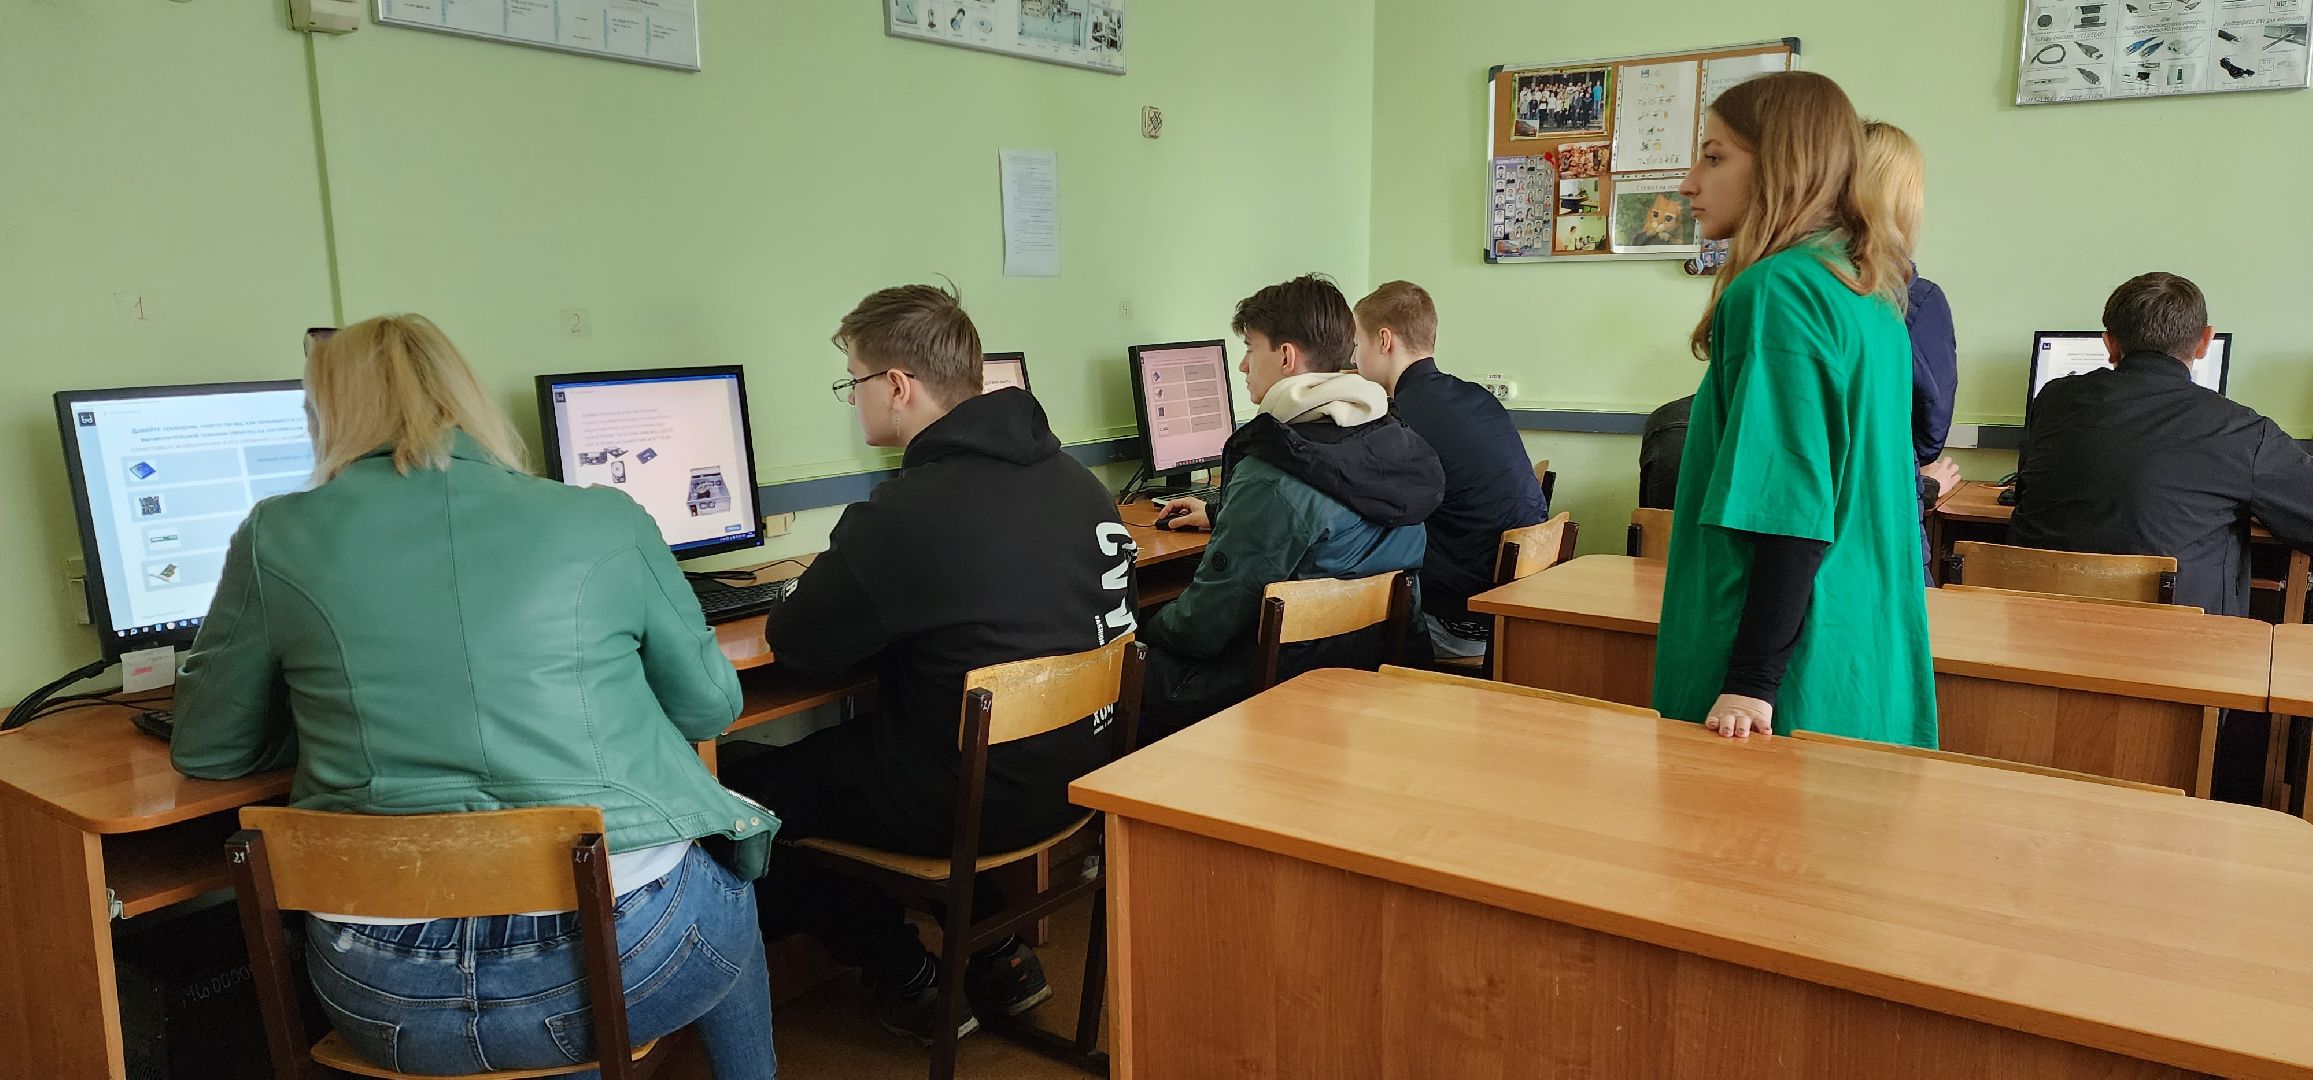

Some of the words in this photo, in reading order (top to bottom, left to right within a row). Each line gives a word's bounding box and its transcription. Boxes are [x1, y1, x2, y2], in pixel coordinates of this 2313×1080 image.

[134, 296, 148, 320] 1
[571, 313, 581, 334] 2
[233, 851, 246, 864] 21
